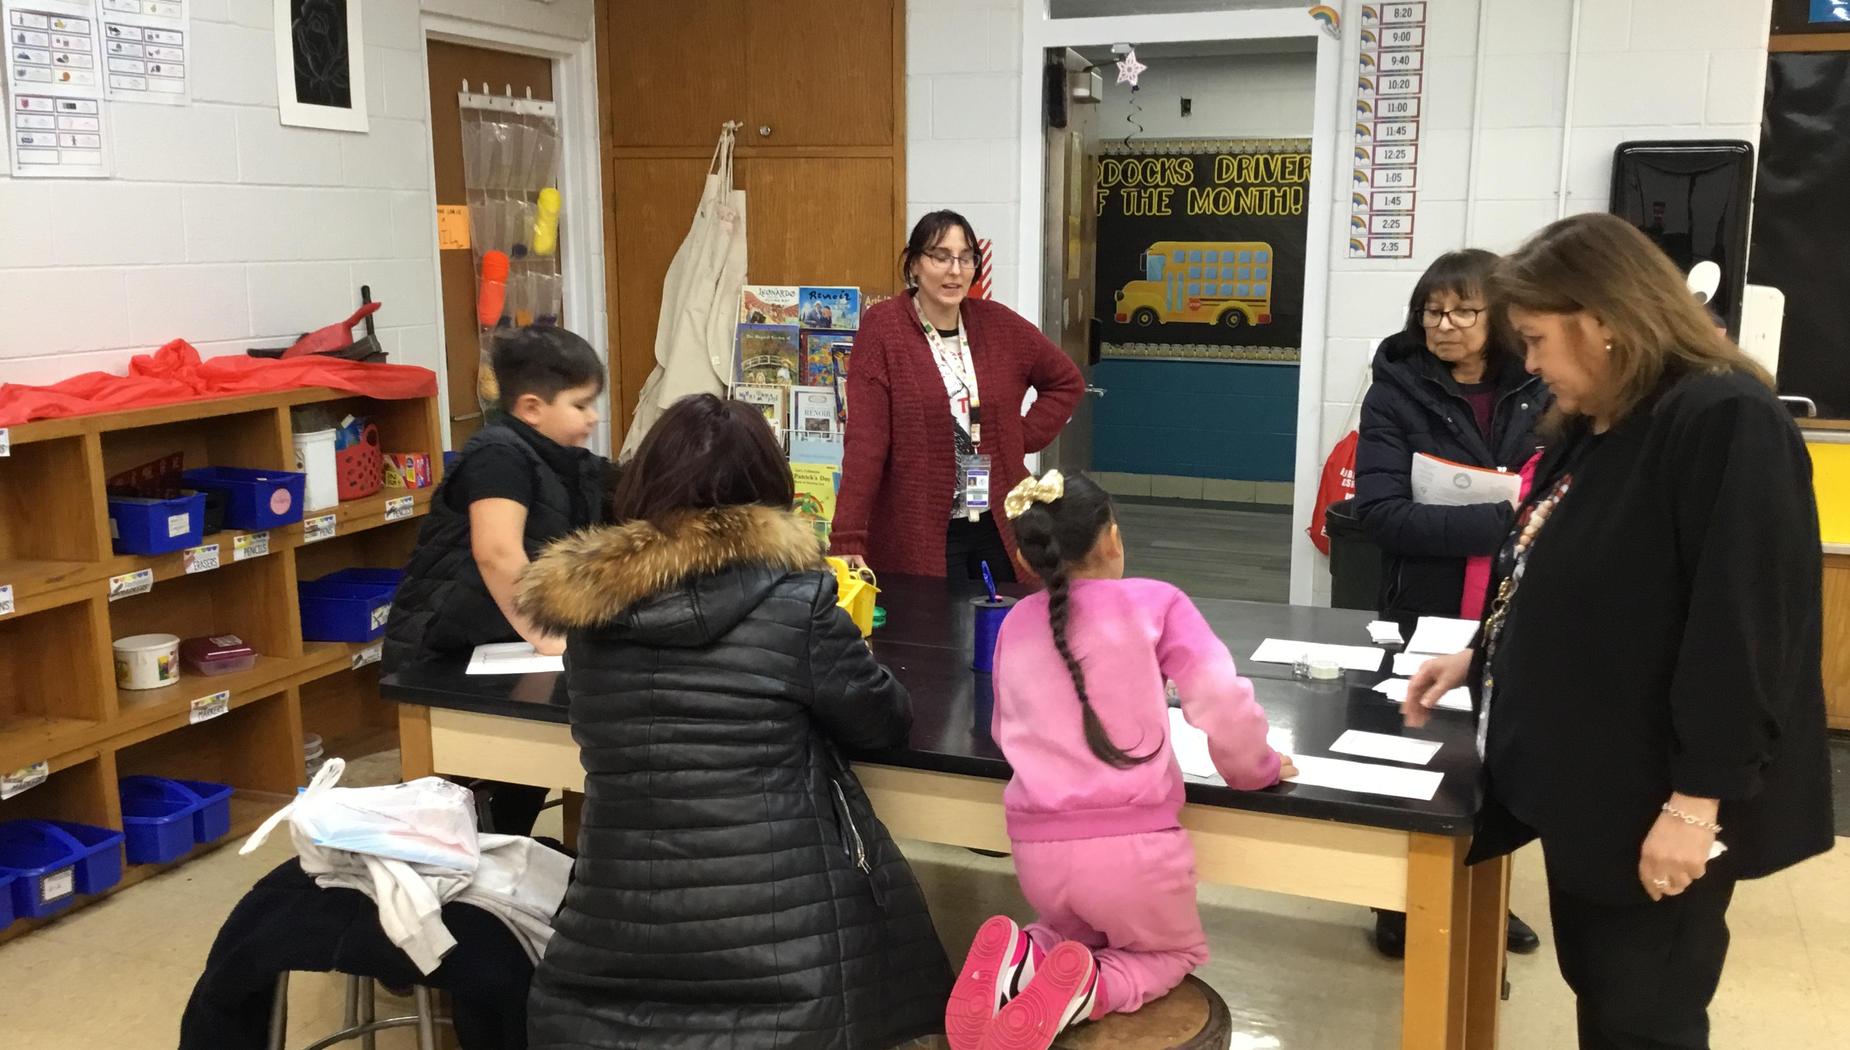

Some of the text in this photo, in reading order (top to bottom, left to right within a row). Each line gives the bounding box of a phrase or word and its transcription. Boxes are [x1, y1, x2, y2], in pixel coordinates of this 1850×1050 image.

[1394, 8, 1412, 18] 8:20
[1393, 31, 1411, 42] 9:00
[1391, 55, 1410, 66] 9:40
[1388, 79, 1410, 90] 10:20
[1387, 103, 1408, 113] 11:00
[1386, 126, 1407, 137] 11:45
[1384, 150, 1406, 160] 12:25
[1385, 173, 1402, 184] 1:05
[1121, 188, 1174, 216] THE
[1187, 186, 1304, 216] MONTH!
[1384, 197, 1402, 207] 1:45
[1382, 219, 1401, 230] 2:25
[1381, 242, 1399, 252] 2:35
[809, 290, 851, 301] Renoir
[243, 544, 267, 557] PENCILS
[193, 557, 218, 571] ERASERS
